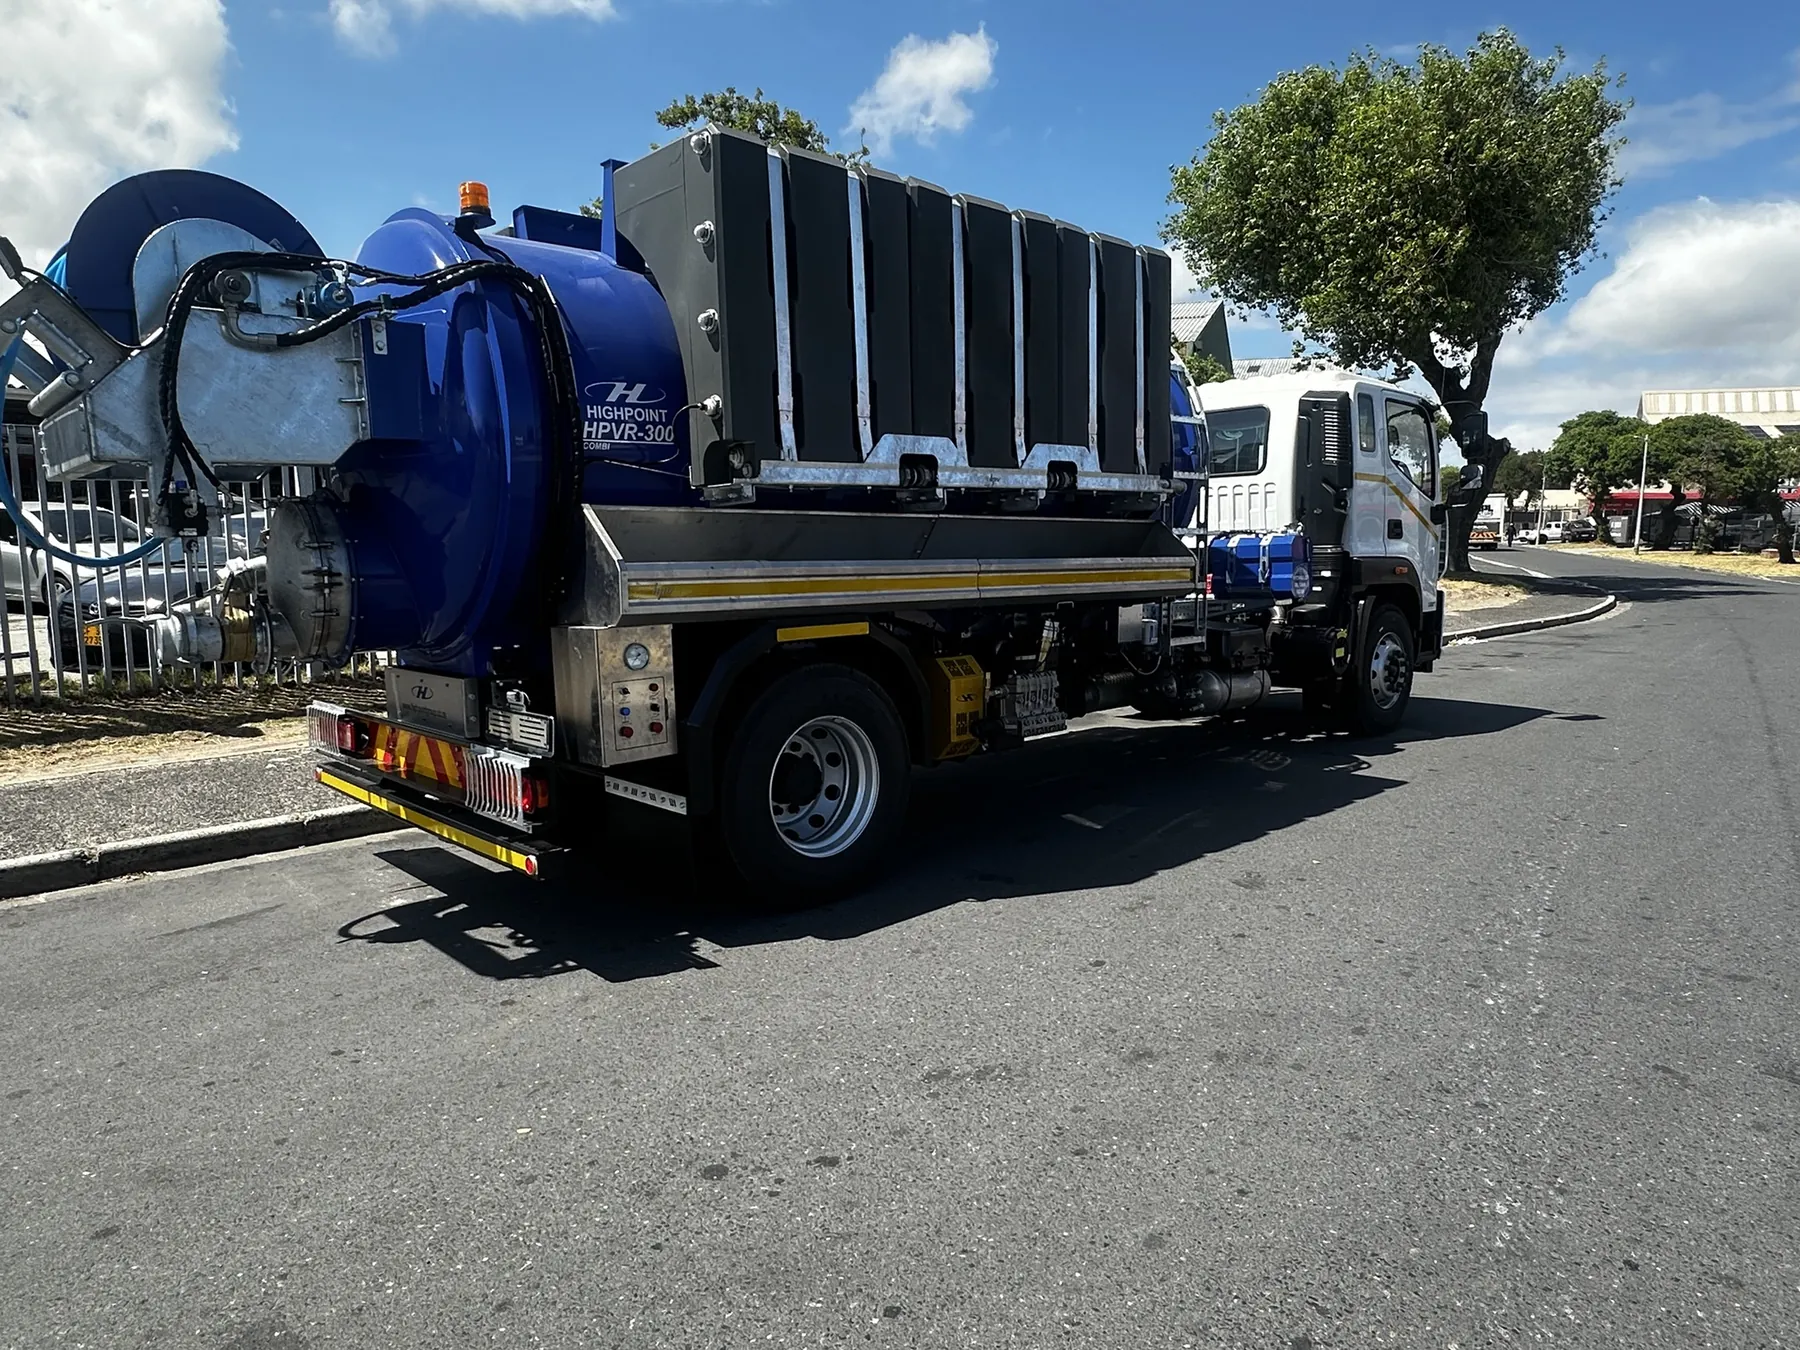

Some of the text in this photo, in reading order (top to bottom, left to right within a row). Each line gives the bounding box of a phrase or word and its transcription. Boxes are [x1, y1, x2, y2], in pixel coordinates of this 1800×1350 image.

[586, 405, 668, 422] HIGHPOINT
[582, 421, 675, 442] HPVR-300
[583, 442, 611, 450] COMBI
